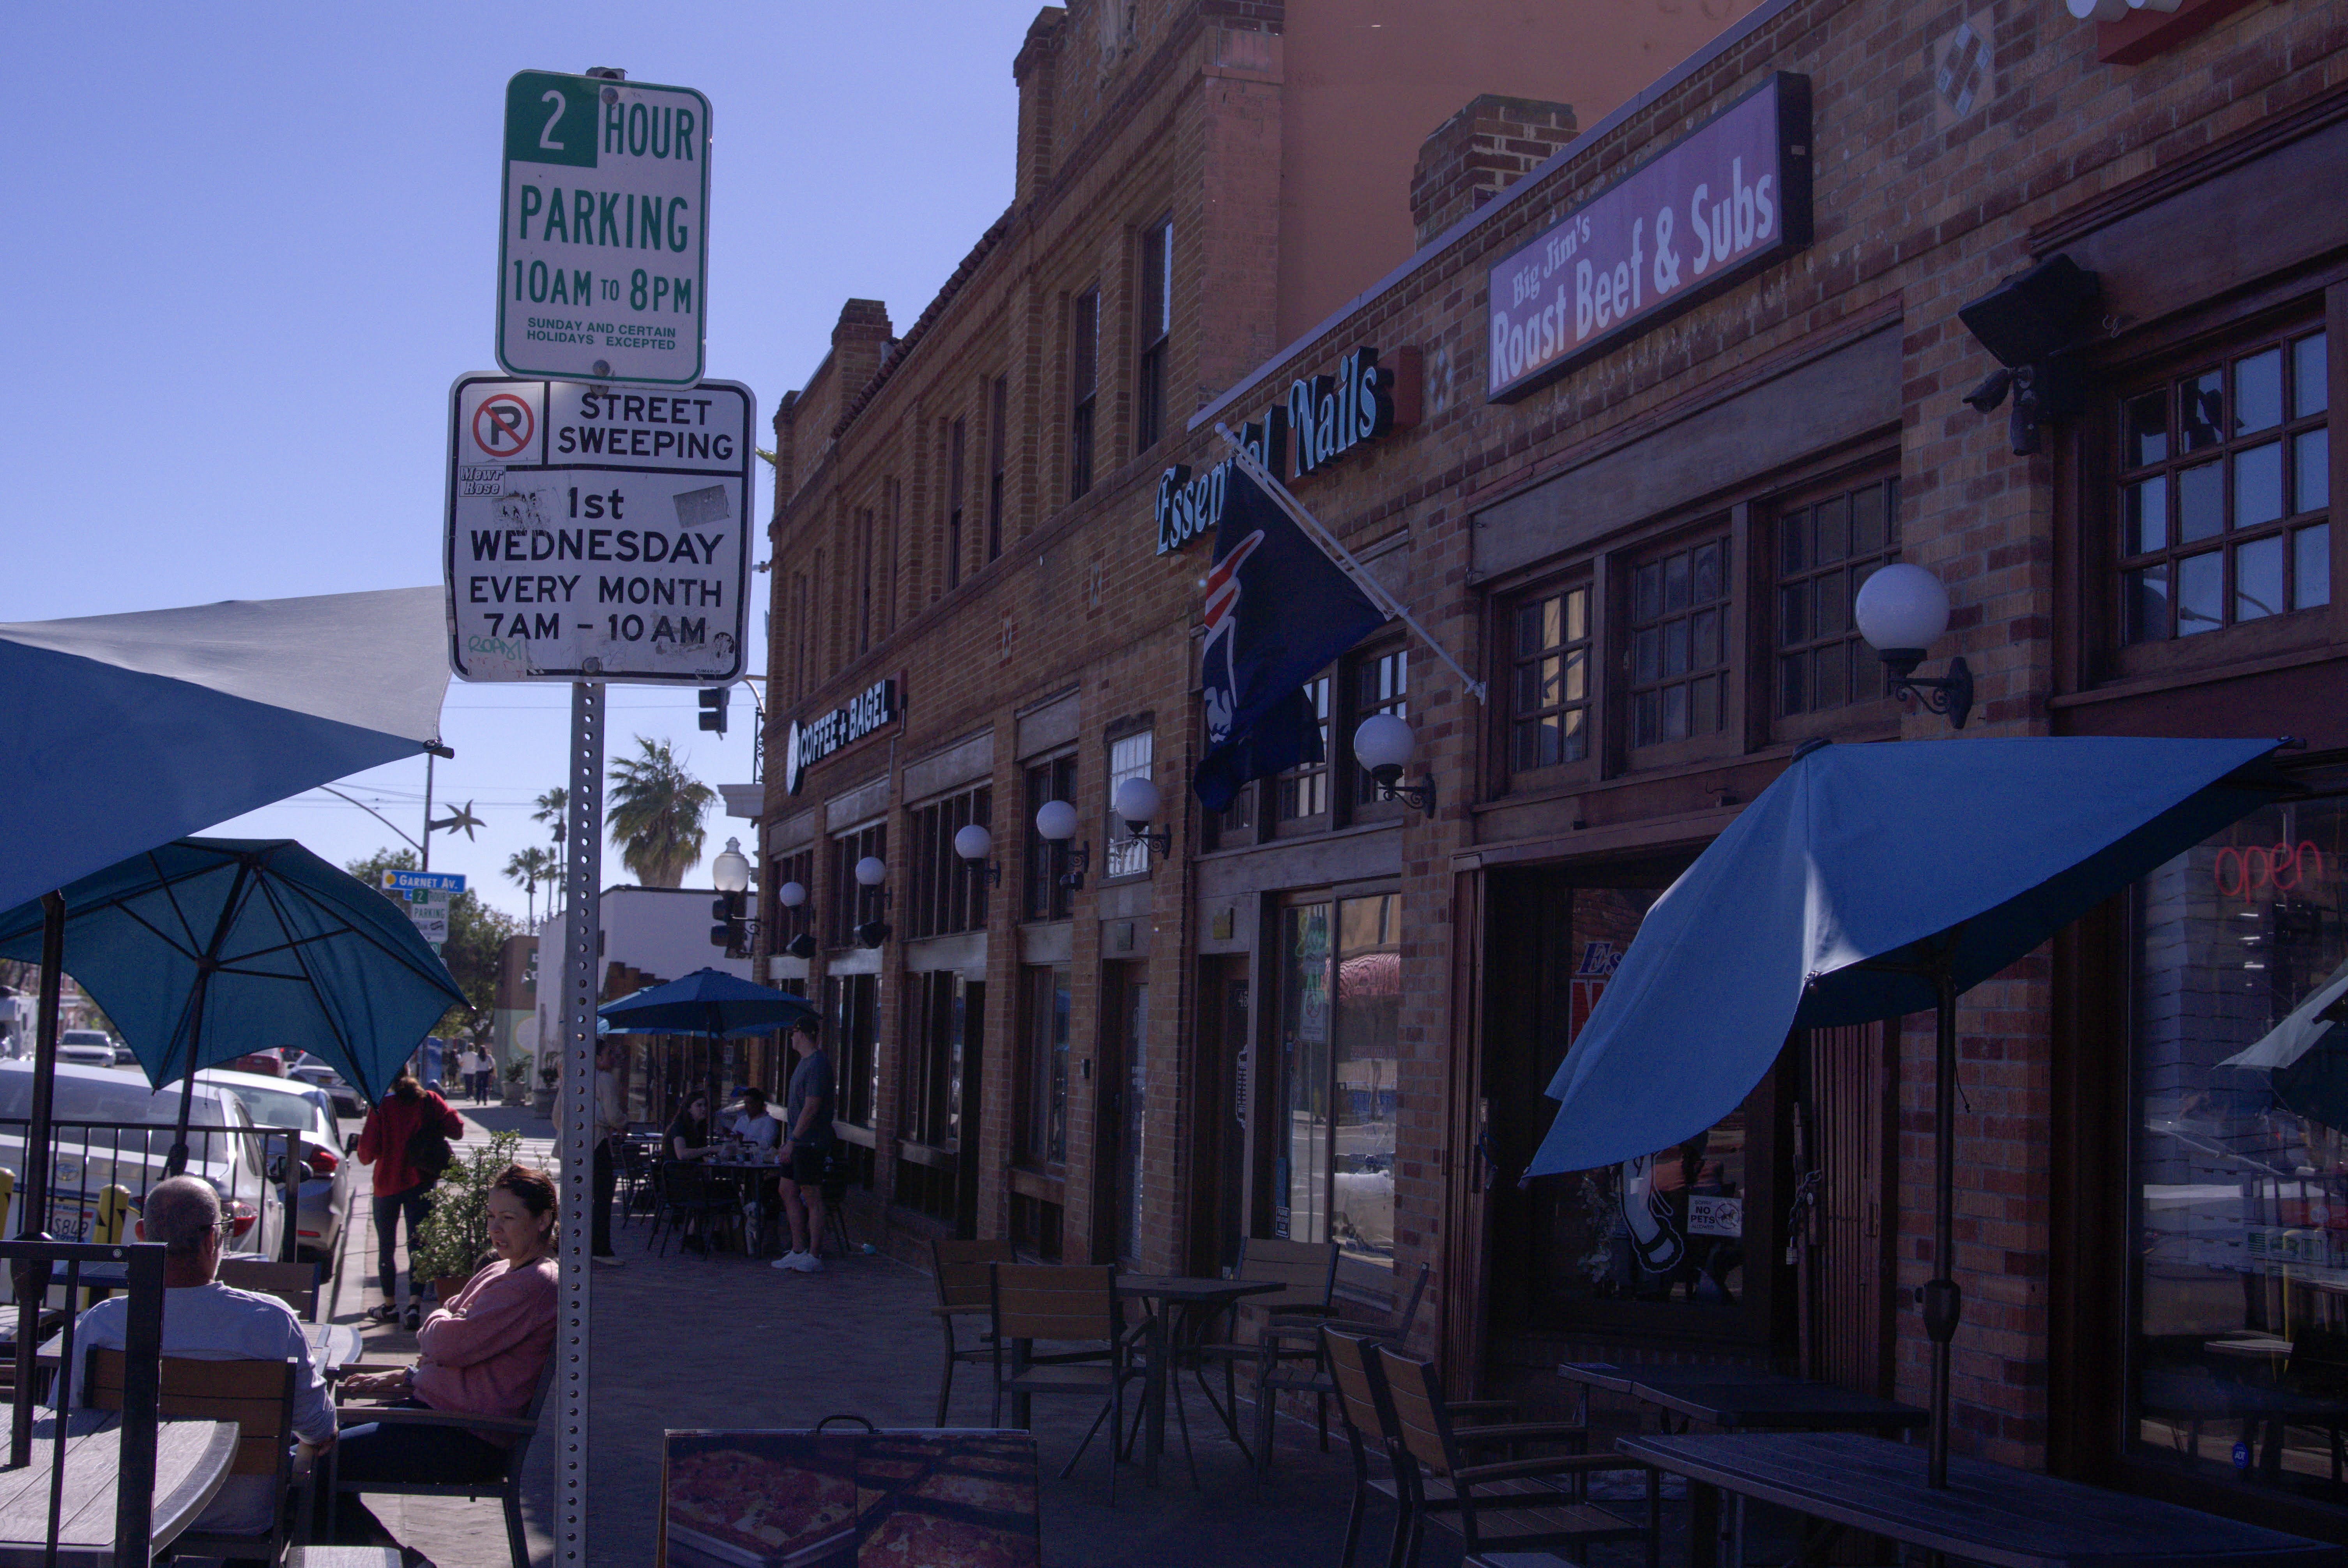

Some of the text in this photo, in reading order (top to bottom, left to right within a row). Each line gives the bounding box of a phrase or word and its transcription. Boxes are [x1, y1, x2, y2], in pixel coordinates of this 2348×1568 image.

[539, 89, 695, 161] 2 HOUR
[520, 185, 688, 253] PARKING
[1492, 156, 1773, 388] Roast Beef & Subs
[1512, 214, 1591, 309] Big Jim's
[514, 259, 691, 314] 10AM TO 8PM
[527, 330, 676, 350] HOLIDAYS EXCEPTED
[528, 317, 676, 338] SUNDAY AND CERTAIN
[580, 392, 713, 426] STREET
[1288, 346, 1378, 478] Nails
[558, 427, 733, 461] SWEEPING
[461, 467, 504, 481] Mewr
[464, 481, 500, 495] Rose
[569, 487, 624, 519] 1st
[471, 529, 725, 565] WEDNESDAY
[470, 575, 722, 607] EVERY MONTH
[483, 613, 560, 640] 7AM
[608, 614, 706, 644] 10AM
[800, 679, 888, 768] COFFEE + BAGEL
[399, 874, 458, 890] GARNET AV.
[2214, 840, 2323, 906] open
[417, 890, 424, 902] 2
[414, 908, 445, 919] PARKING
[1690, 1214, 1715, 1224] PETS
[1696, 1206, 1711, 1215] NO
[2234, 1450, 2245, 1462] ADT
